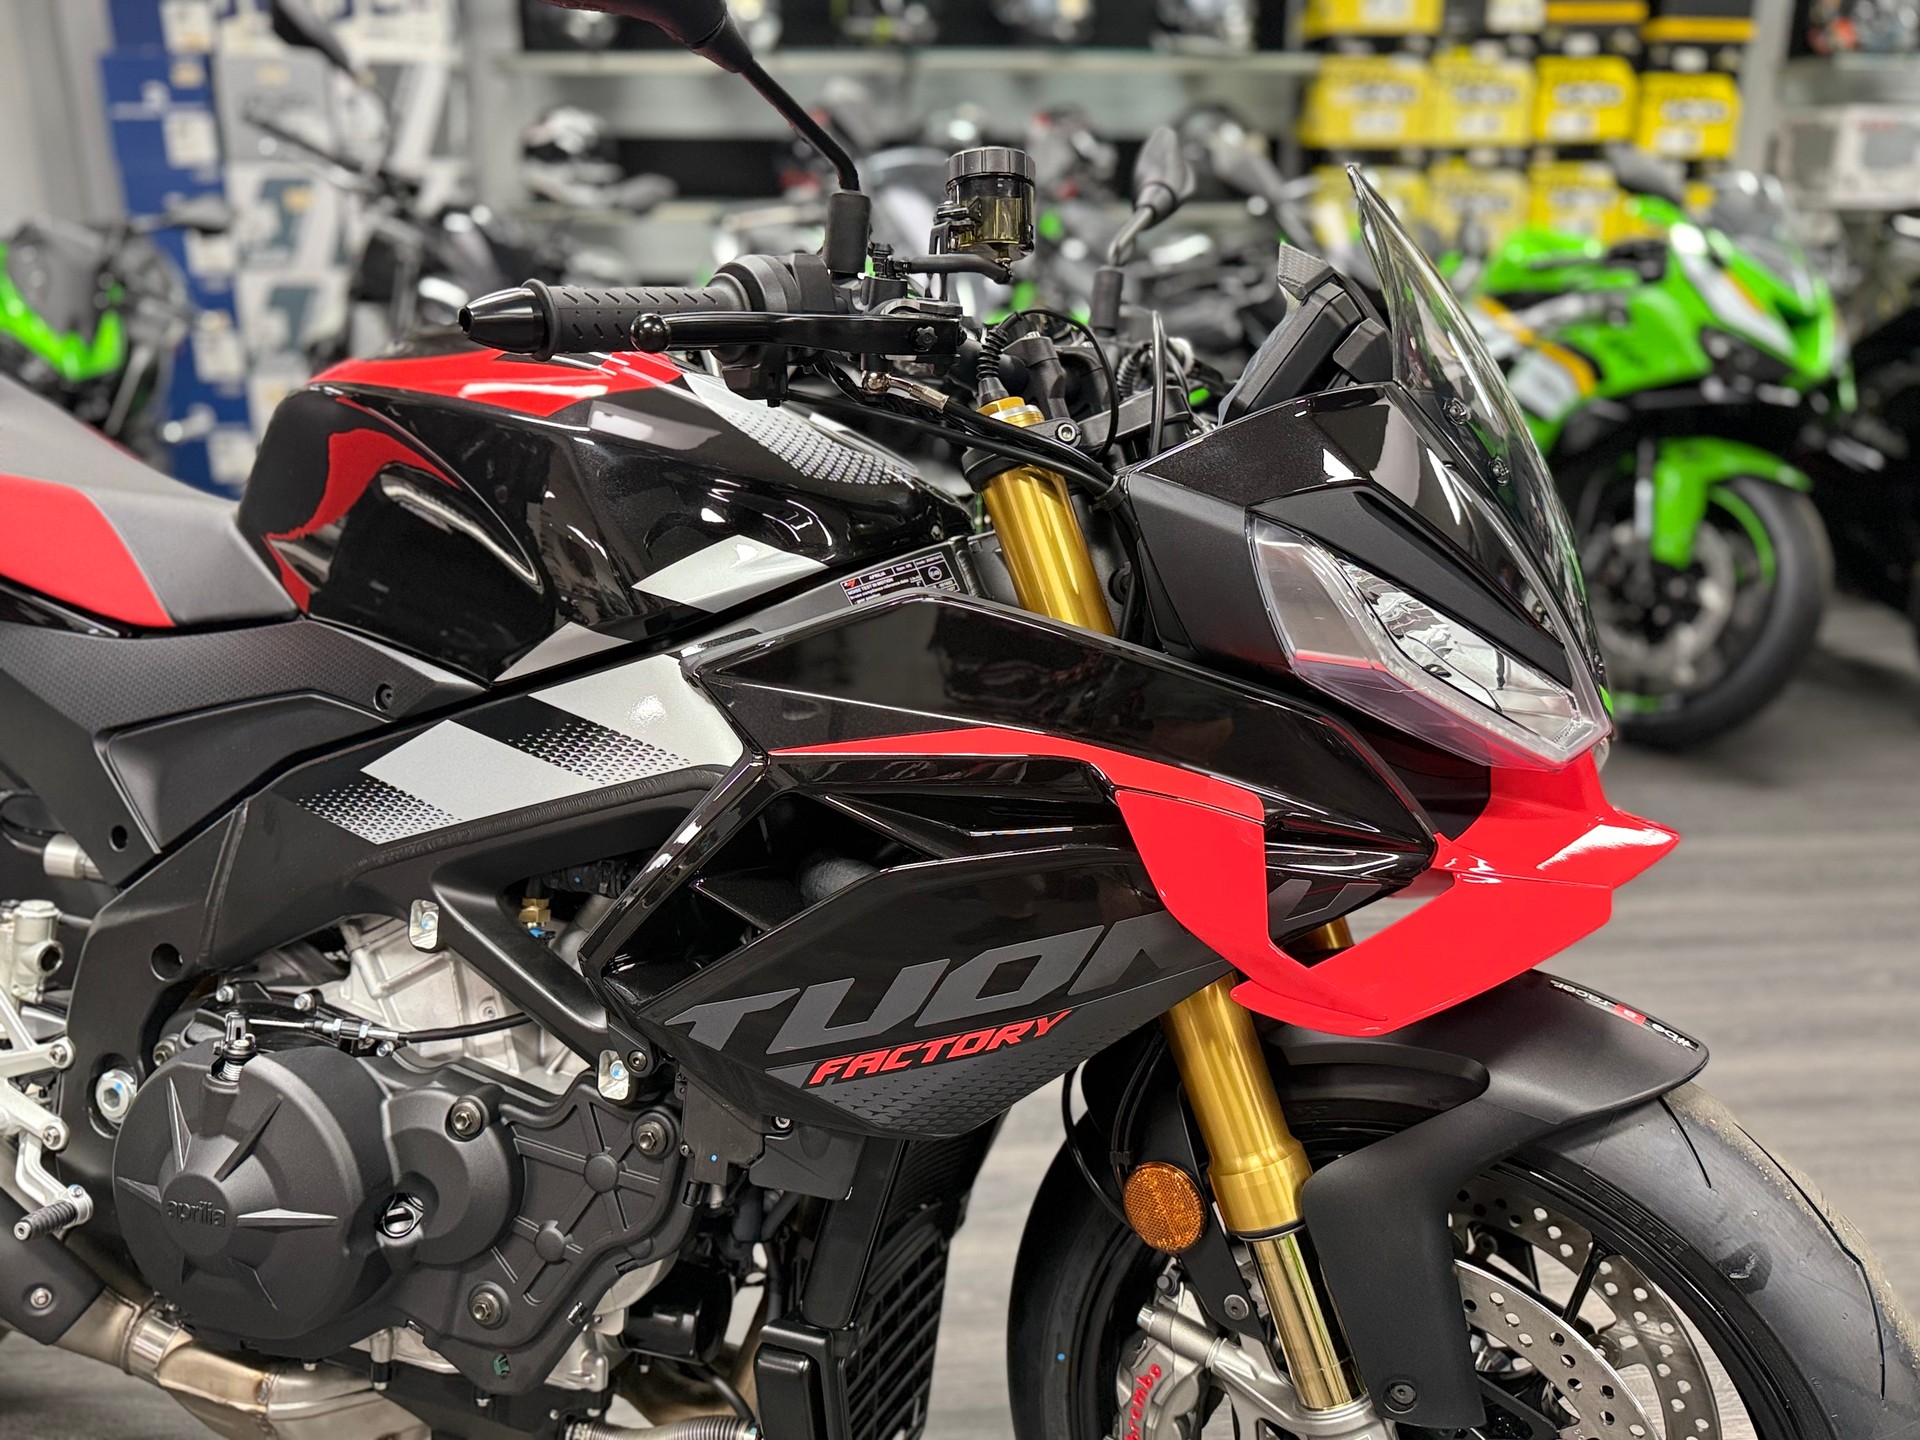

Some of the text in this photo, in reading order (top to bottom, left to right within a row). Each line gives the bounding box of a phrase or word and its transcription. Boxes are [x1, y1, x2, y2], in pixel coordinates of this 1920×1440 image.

[868, 571, 887, 580] APRILIA
[877, 577, 894, 586] MOTION
[664, 910, 1190, 1054] TUON
[807, 1008, 1073, 1087] FACTORY
[167, 1200, 226, 1228] aprilia
[1125, 1364, 1162, 1440] brembo
